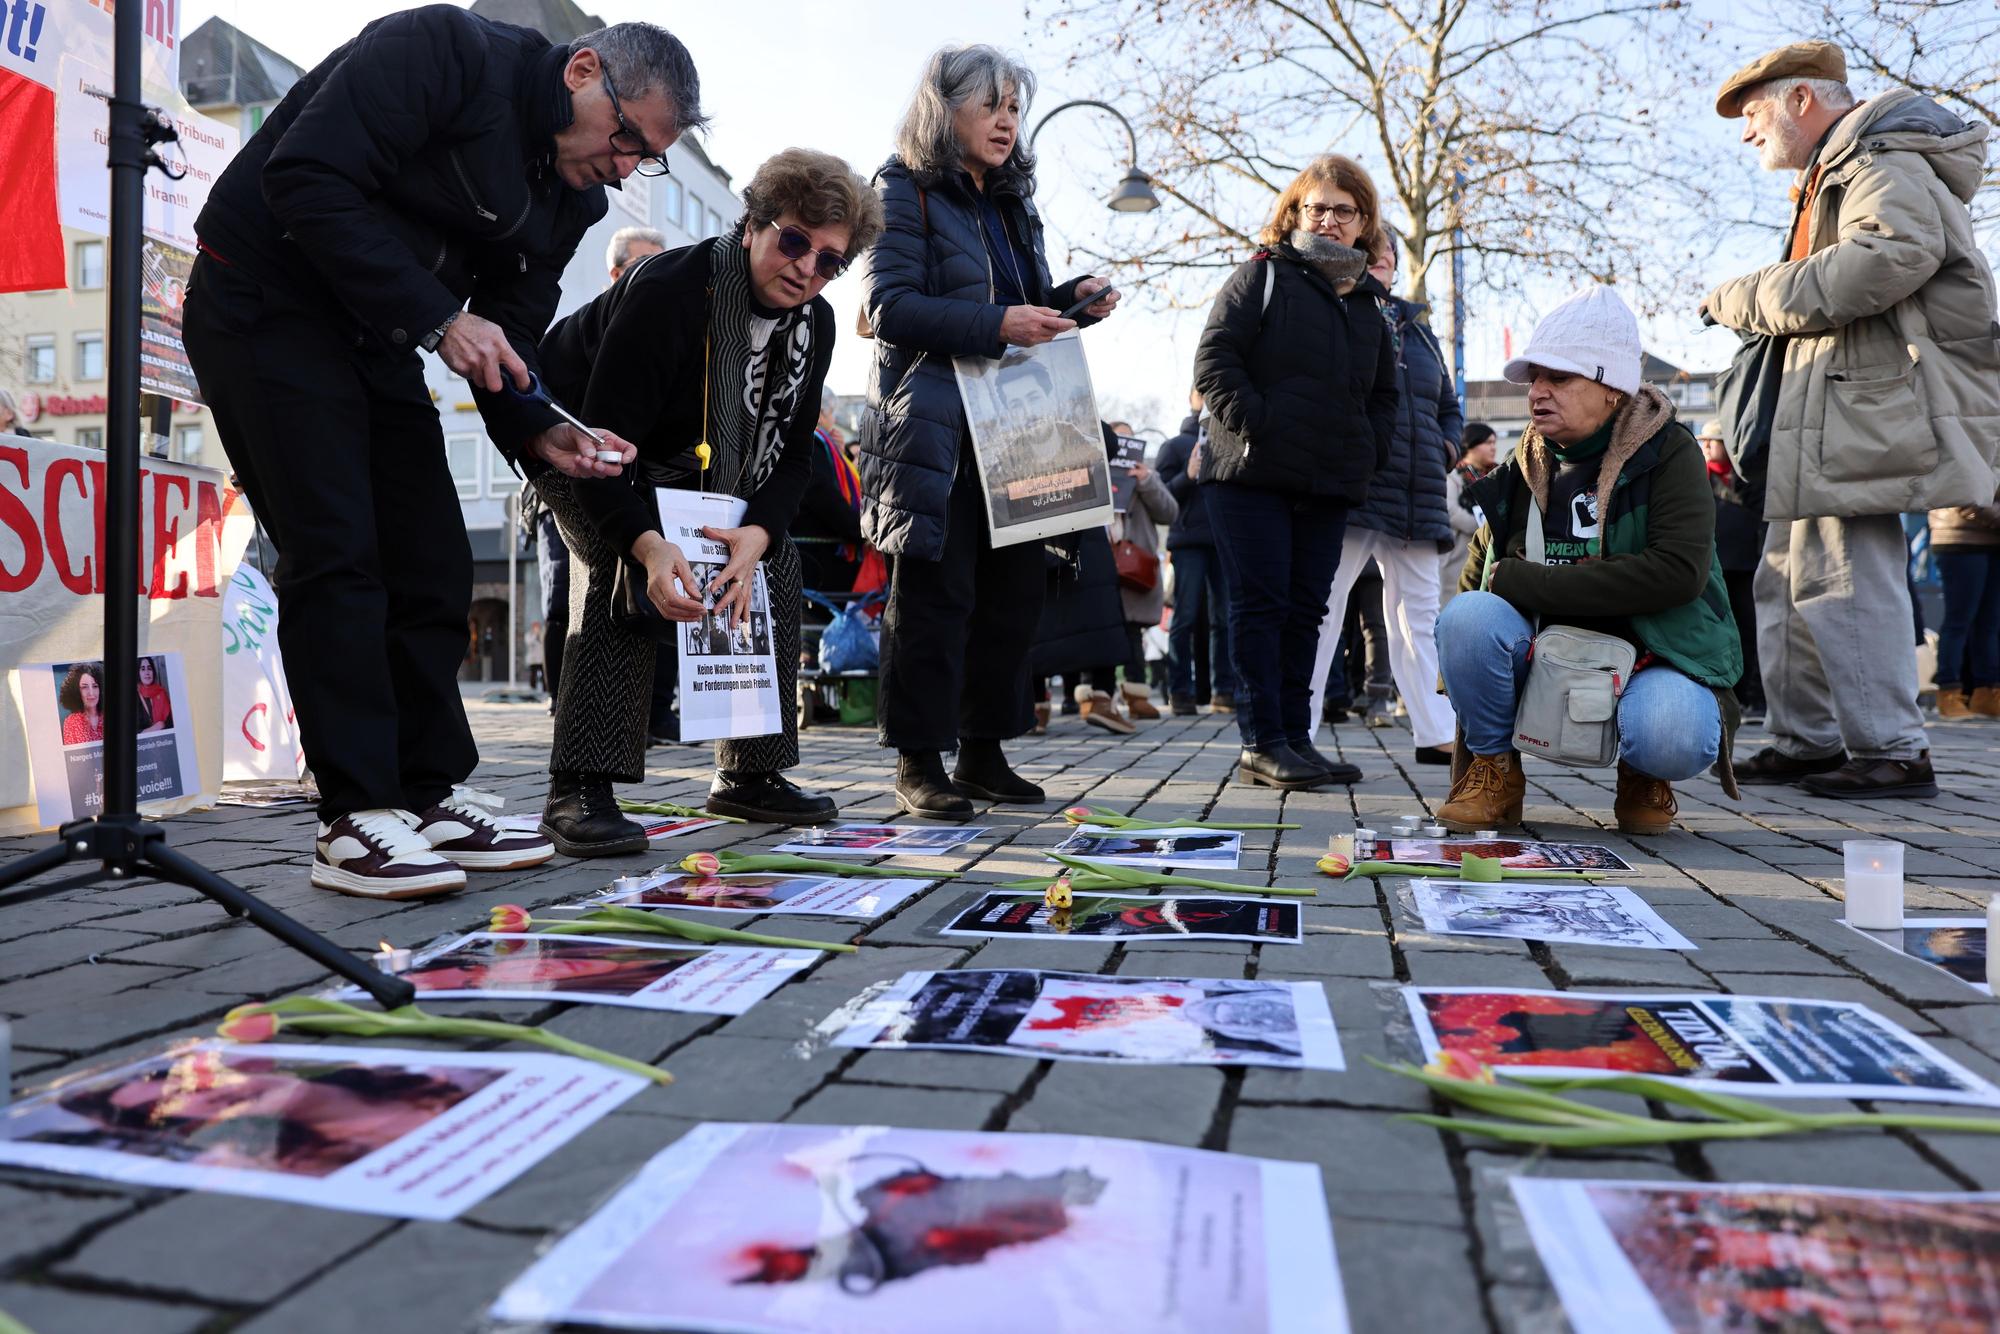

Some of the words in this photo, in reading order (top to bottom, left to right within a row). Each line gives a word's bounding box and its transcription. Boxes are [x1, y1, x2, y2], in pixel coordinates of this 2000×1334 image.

[93, 128, 109, 147] fü
[176, 120, 225, 151] Tribunal
[151, 185, 189, 209] Iran!!!
[697, 663, 714, 676] Keine
[713, 663, 735, 675] Waffen.
[735, 662, 750, 675] Keine
[749, 663, 768, 674] Gewalt.
[693, 680, 704, 692] Nur
[704, 679, 740, 692] Forderungen
[739, 678, 753, 690] nach
[753, 677, 772, 689] Freiheit.
[70, 752, 93, 763] Narges
[136, 762, 158, 773] soners
[1657, 1008, 1724, 1044] KILL
[1693, 1043, 1752, 1070] TO
